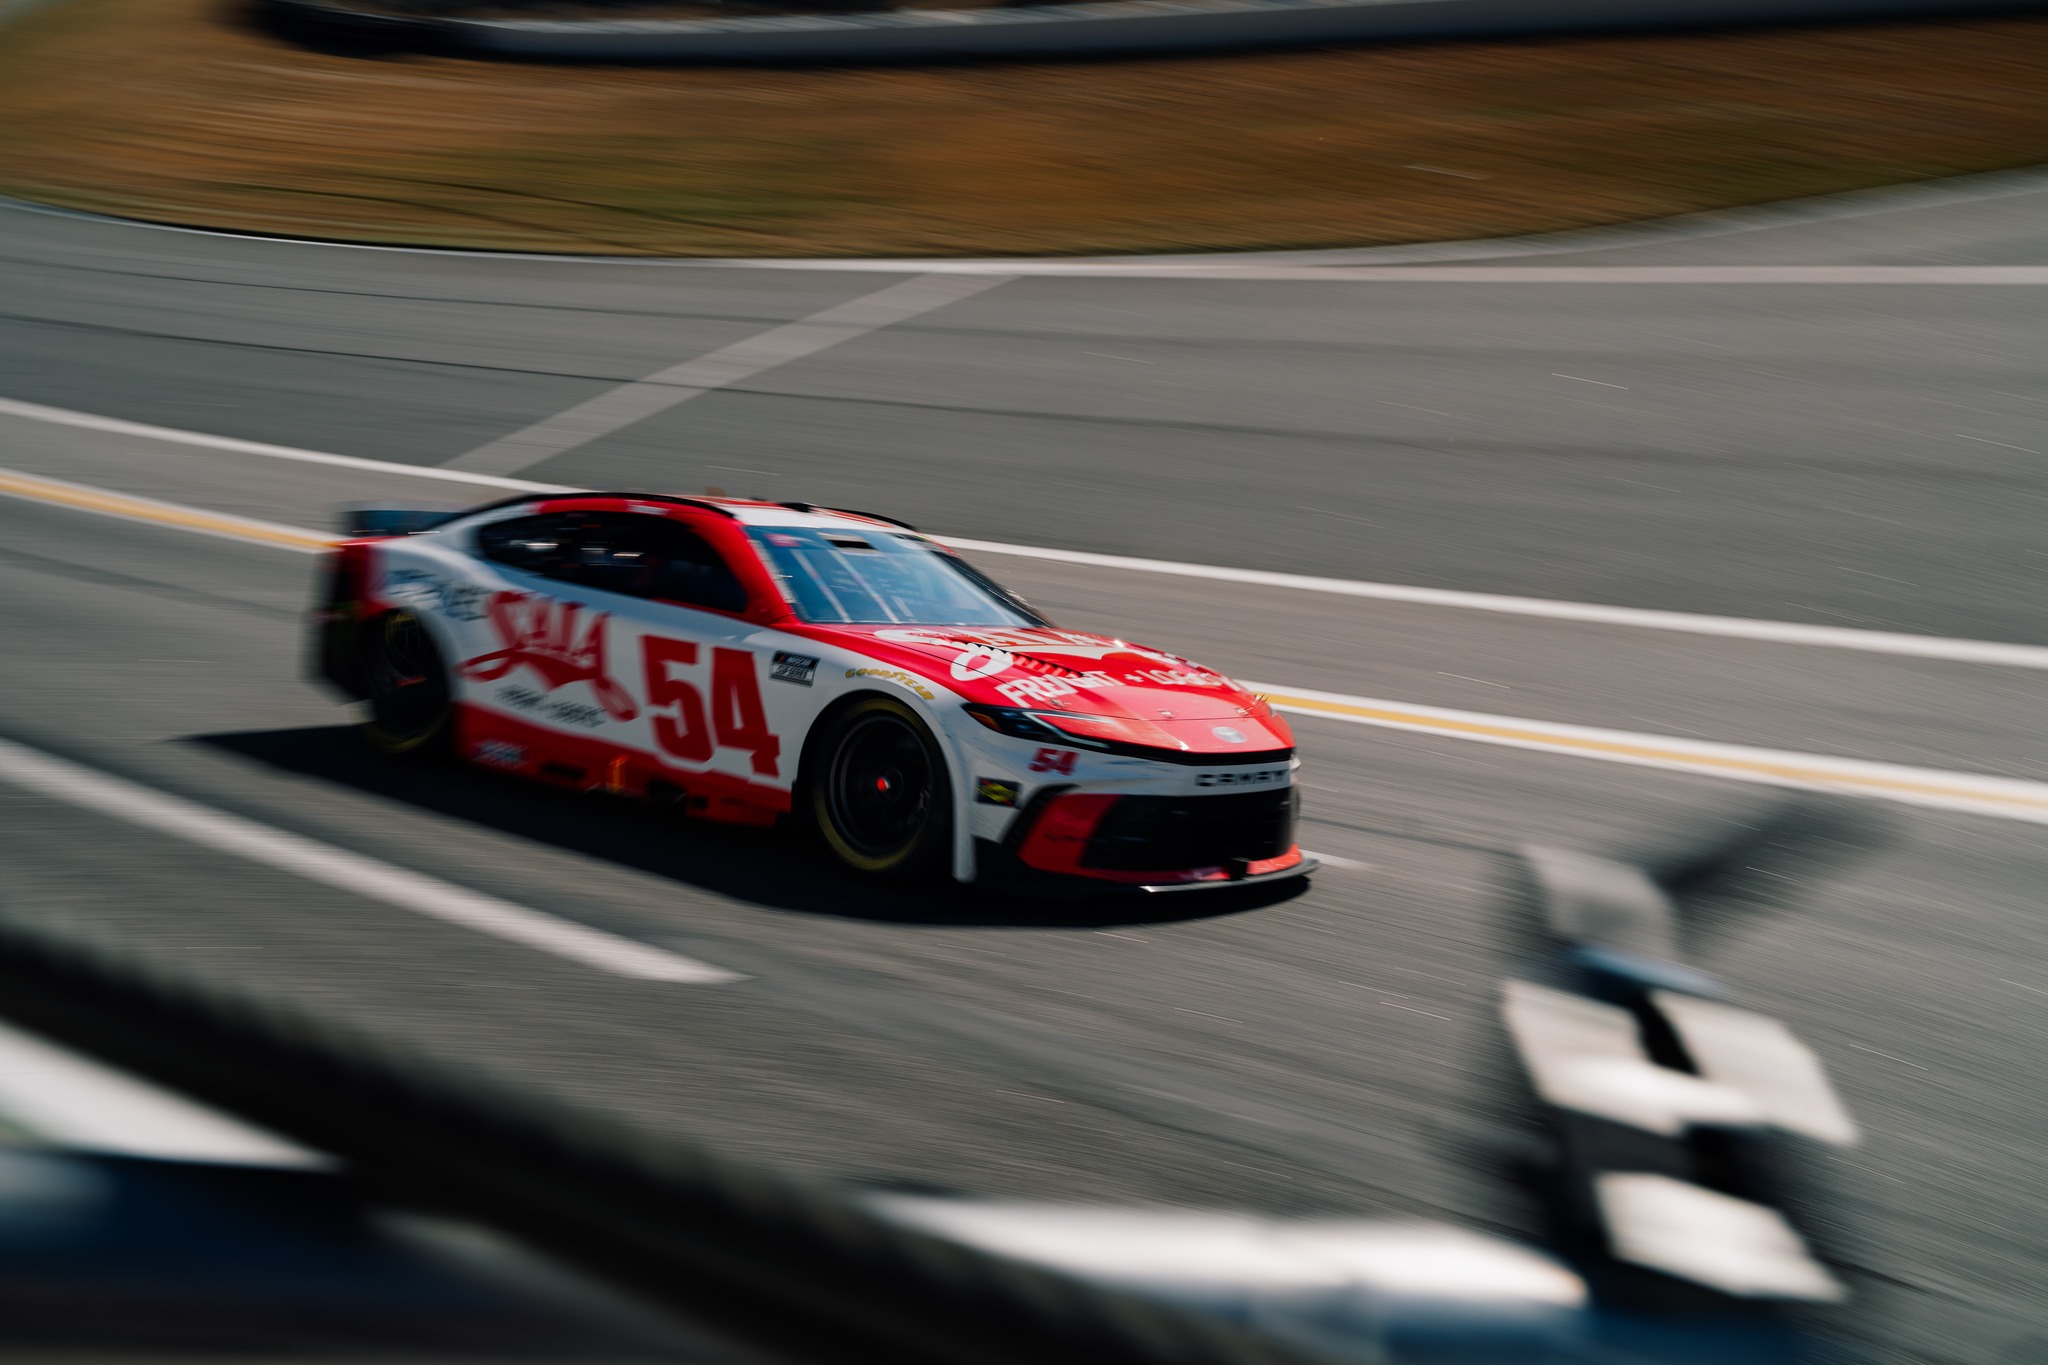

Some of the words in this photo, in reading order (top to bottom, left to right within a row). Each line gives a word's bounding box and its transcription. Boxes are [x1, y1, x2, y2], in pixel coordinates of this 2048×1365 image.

[845, 667, 935, 700] GOODYEAR
[994, 670, 1126, 708] FREIGHT
[642, 633, 781, 779] 54
[1028, 747, 1080, 776] 54
